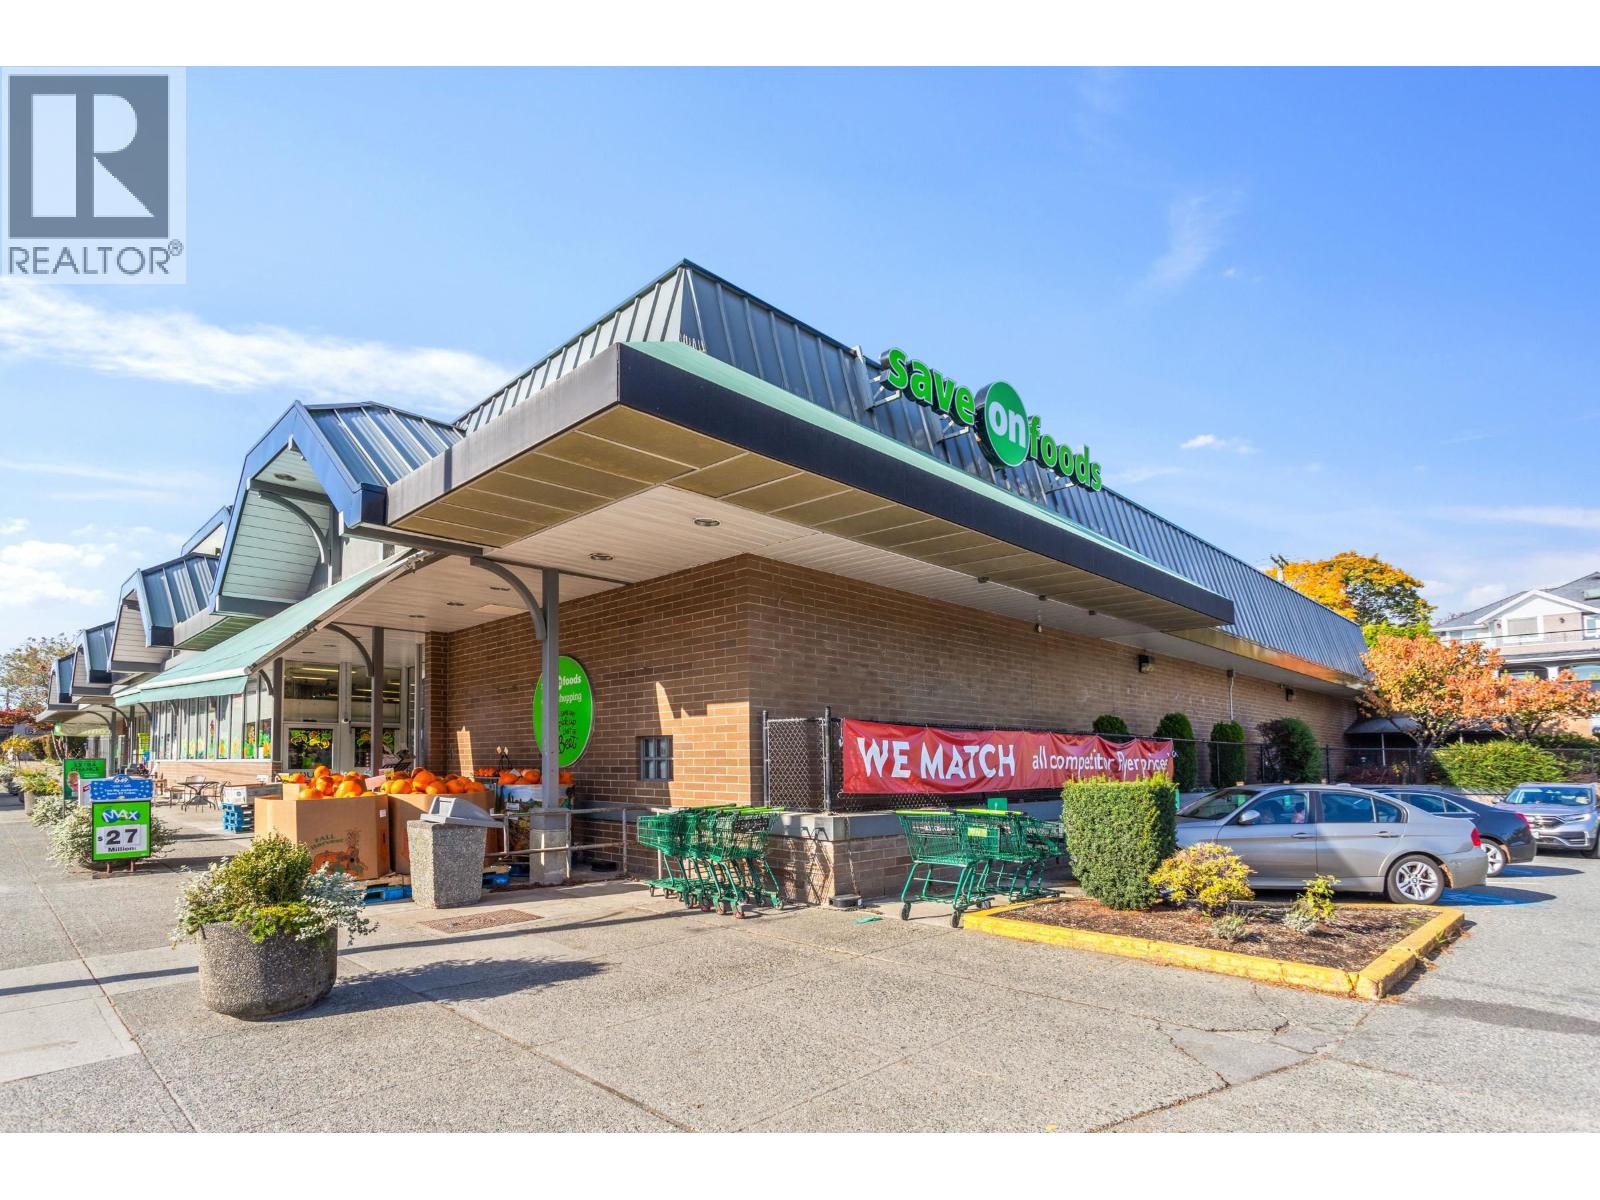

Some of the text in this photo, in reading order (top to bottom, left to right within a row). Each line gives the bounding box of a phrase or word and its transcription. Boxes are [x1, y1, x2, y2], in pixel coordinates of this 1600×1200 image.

[886, 347, 1102, 491] save on foods
[562, 673, 582, 686] foods
[559, 692, 582, 705] hopping
[857, 737, 912, 778] WE
[920, 742, 1016, 780] MATCH
[1032, 745, 1048, 770] all
[1049, 748, 1116, 780] competitor
